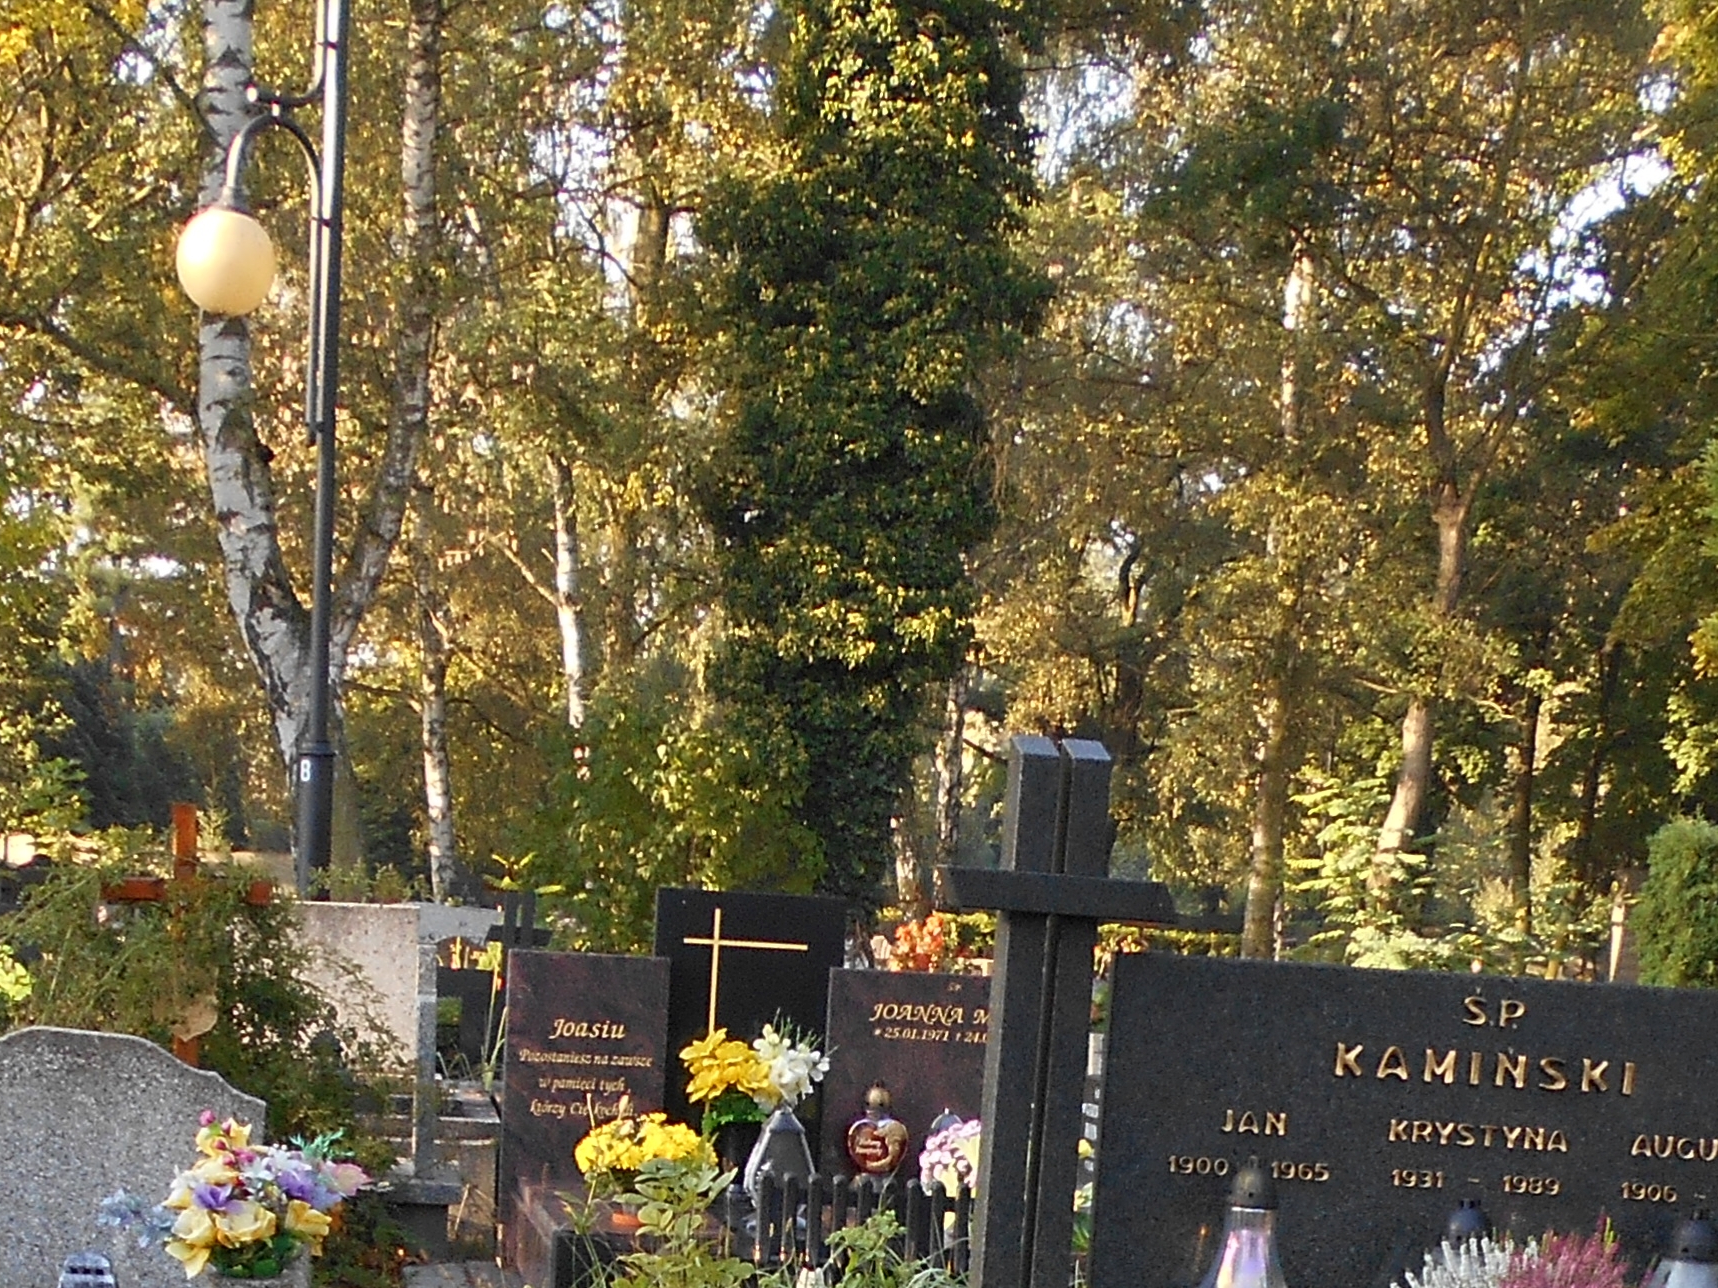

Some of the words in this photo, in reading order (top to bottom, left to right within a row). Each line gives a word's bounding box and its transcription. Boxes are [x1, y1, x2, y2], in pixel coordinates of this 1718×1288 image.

[868, 1003, 964, 1026] JOANNA
[548, 1018, 626, 1040] Joasiu
[519, 1048, 592, 1066] Pozostaniesz
[593, 1055, 609, 1065] na
[610, 1056, 653, 1067] zawsze
[538, 1077, 551, 1089] w
[1221, 1109, 1287, 1136] JAN
[1388, 1118, 1568, 1153] KRYSTYNA
[1168, 1155, 1229, 1176] 1900
[1271, 1161, 1330, 1182] 1965
[1392, 1168, 1444, 1188] 1931
[1502, 1174, 1561, 1196] 1989
[1621, 1181, 1677, 1203] 1906
